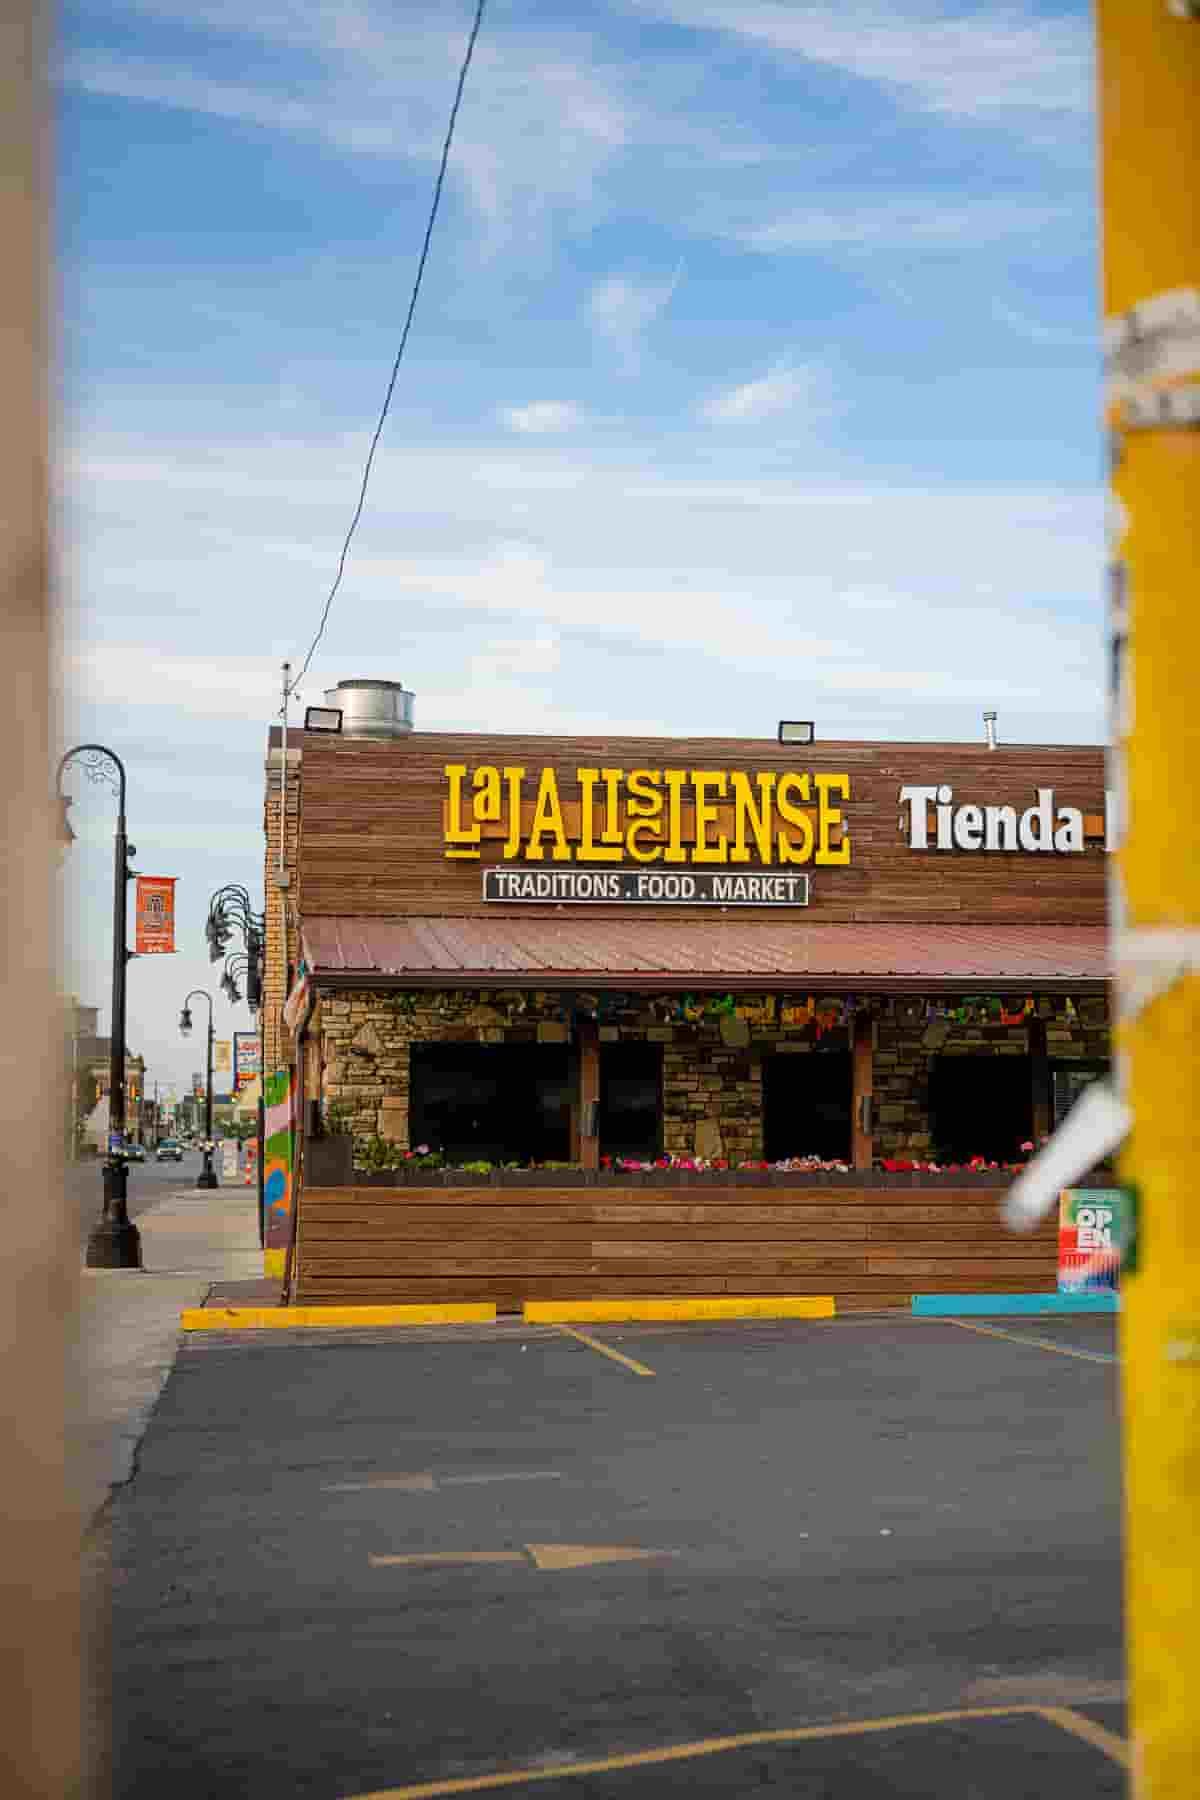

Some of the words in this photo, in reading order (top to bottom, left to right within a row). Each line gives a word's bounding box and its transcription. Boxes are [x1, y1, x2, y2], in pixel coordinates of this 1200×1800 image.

[443, 764, 500, 859] La
[899, 785, 1084, 852] Tienda
[494, 873, 620, 898] TRADITIONS
[638, 875, 695, 899] FOOD
[712, 876, 799, 901] MARKET
